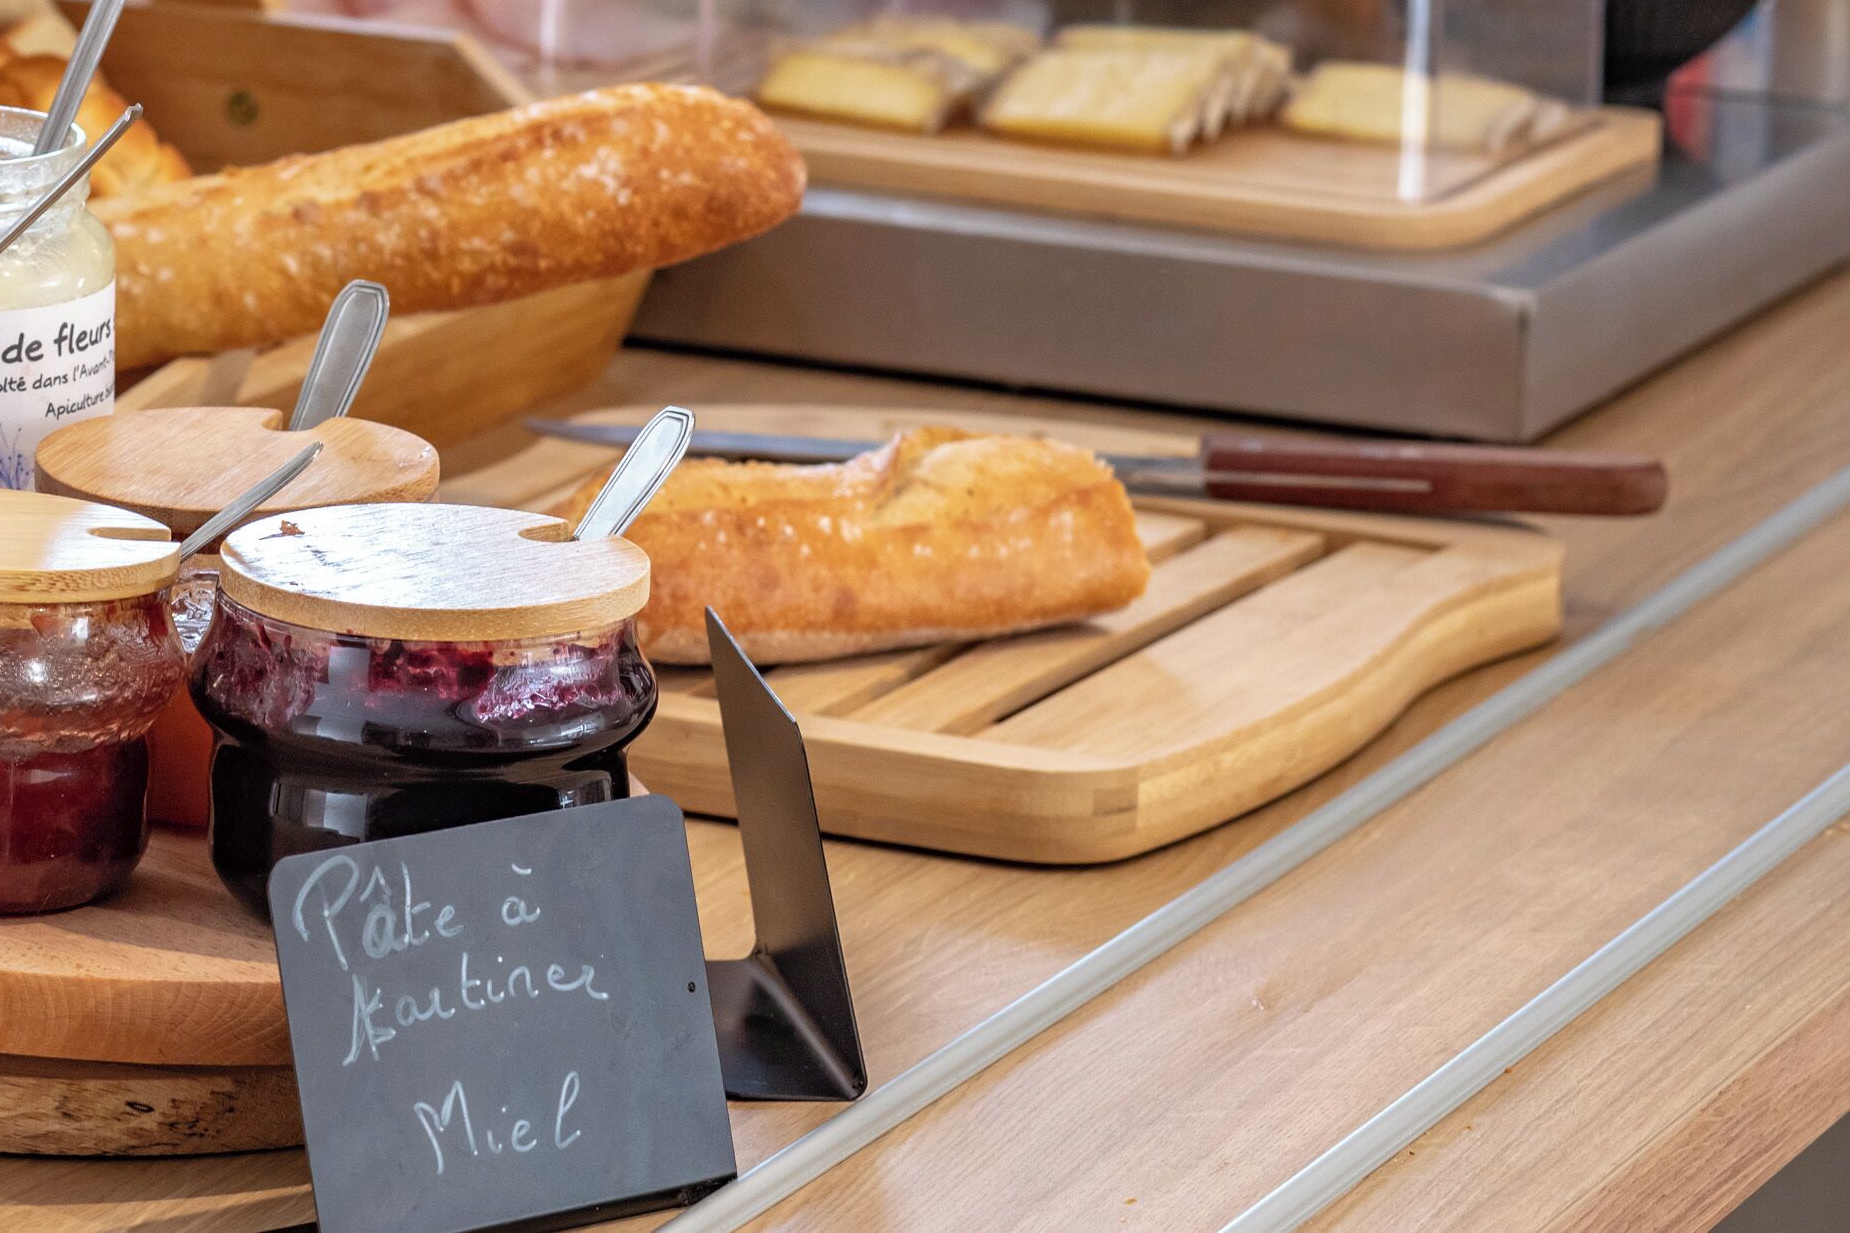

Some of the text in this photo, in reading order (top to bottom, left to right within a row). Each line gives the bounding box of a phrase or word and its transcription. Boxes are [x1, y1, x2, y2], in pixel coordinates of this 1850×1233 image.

[1, 332, 45, 364] de
[53, 318, 111, 357] fleurs
[32, 373, 69, 390] dans
[72, 349, 115, 382] l'Avant-
[292, 854, 541, 971] Pâte à
[414, 1070, 582, 1176] Miel
